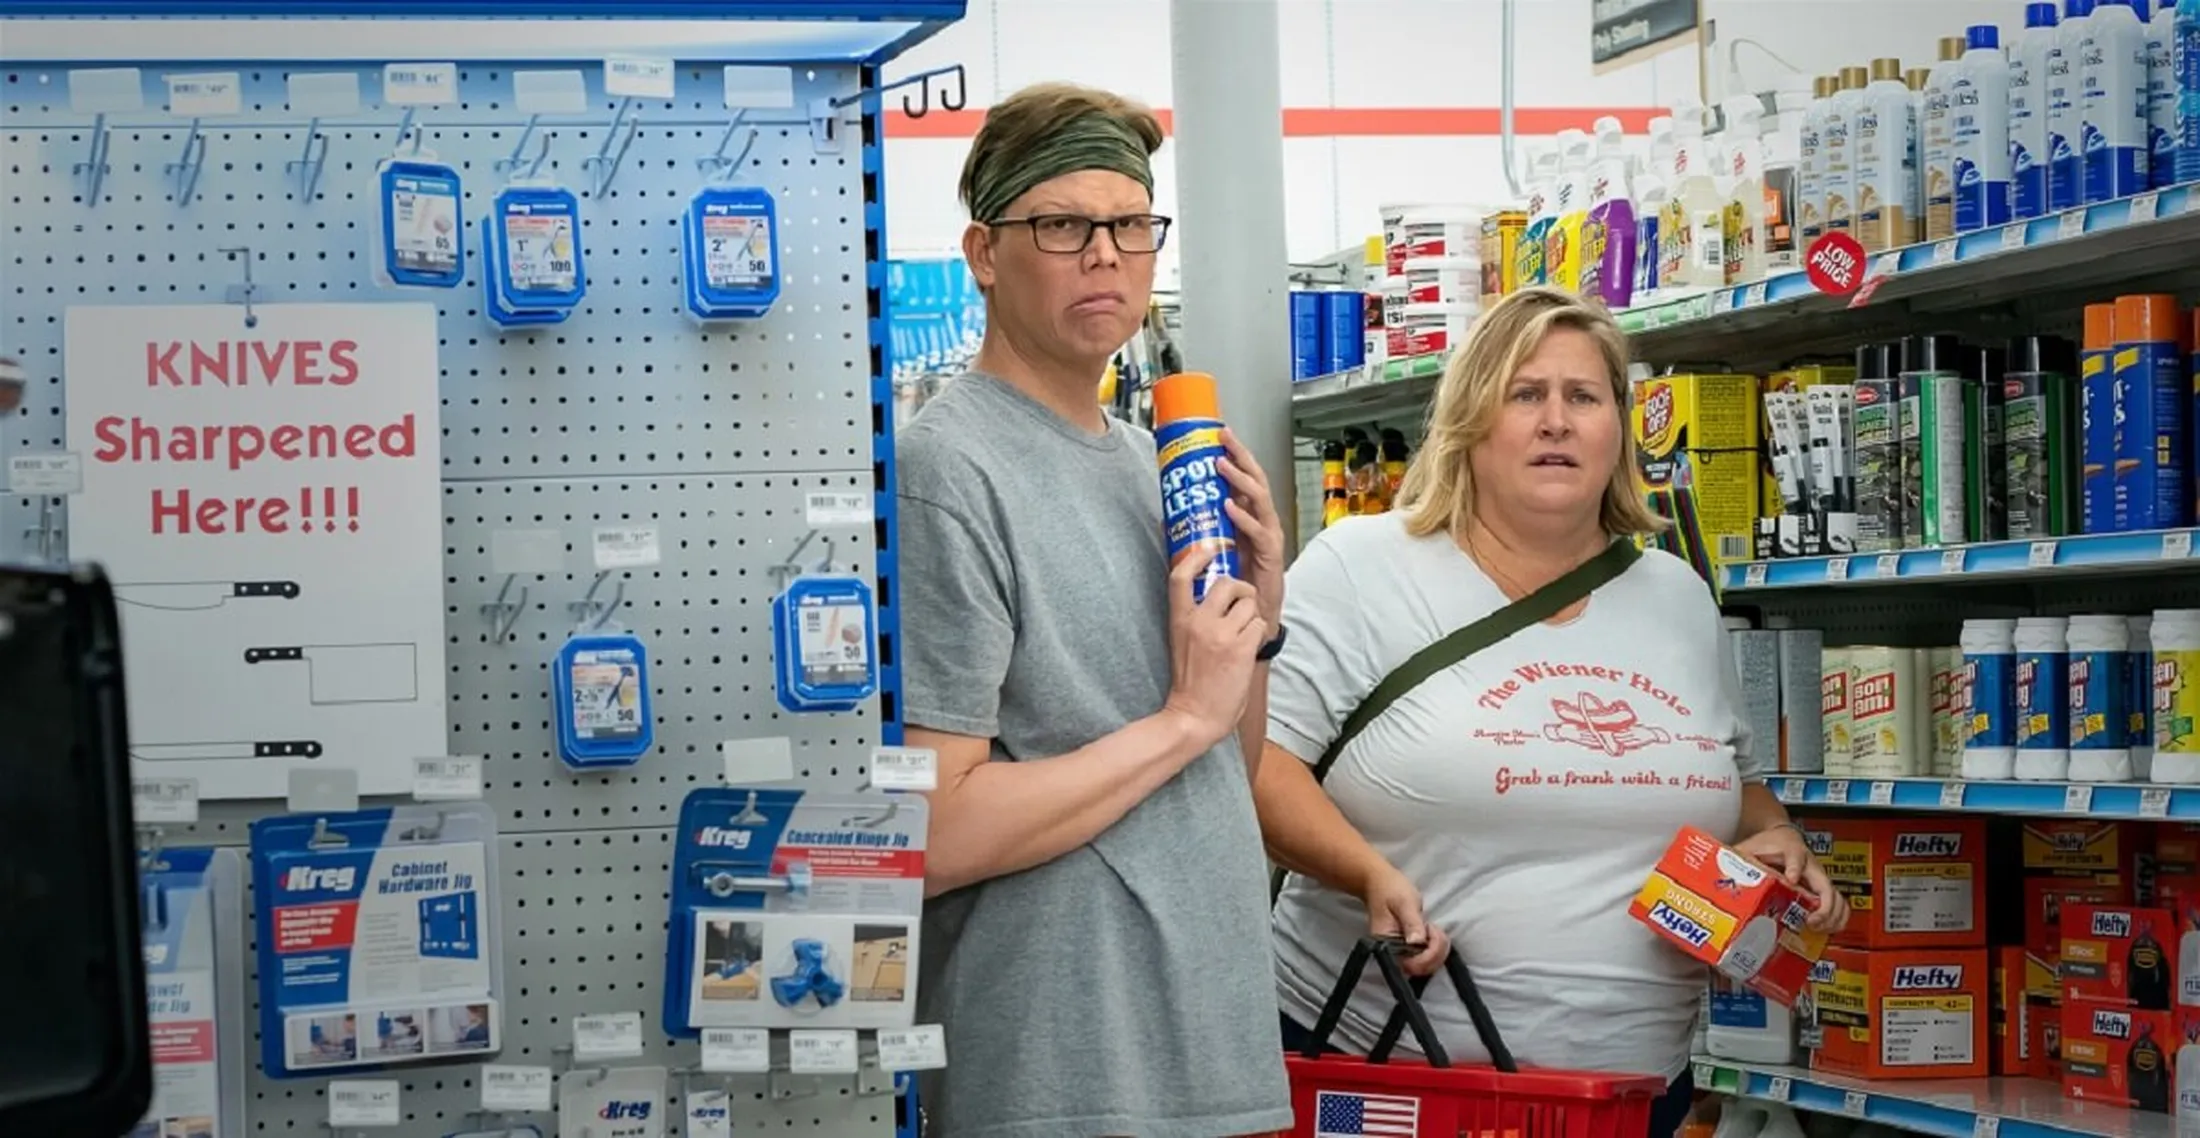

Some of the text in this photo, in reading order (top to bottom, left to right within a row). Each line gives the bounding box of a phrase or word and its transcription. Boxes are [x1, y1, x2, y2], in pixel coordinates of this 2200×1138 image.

[1810, 250, 1853, 288] PRICE
[1823, 241, 1856, 271] LOW
[146, 339, 360, 387] KNIVES
[93, 413, 417, 470] Sharpened
[1161, 455, 1218, 497] SPOT
[150, 486, 361, 535] Here!!!
[1165, 480, 1221, 519] LESS
[1477, 660, 1692, 717] The Wiener Hole
[1495, 767, 1542, 794] Grab
[1547, 775, 1560, 785] a
[1563, 769, 1614, 787] frank
[1621, 772, 1662, 786] with
[1669, 775, 1679, 786] a
[699, 826, 752, 850] Kreg
[786, 829, 854, 847] Concealed
[892, 832, 910, 848] Jig
[1897, 833, 1958, 854] Hefty
[285, 865, 357, 892] Kreg
[391, 860, 448, 878] Cabinet
[378, 873, 473, 895] Hardware Jig
[1653, 904, 1710, 945] Hefty
[2094, 913, 2130, 937] Hefty
[1896, 968, 1959, 987] Hefty
[2094, 1011, 2130, 1037] Hefty
[607, 1100, 652, 1121] Kreg
